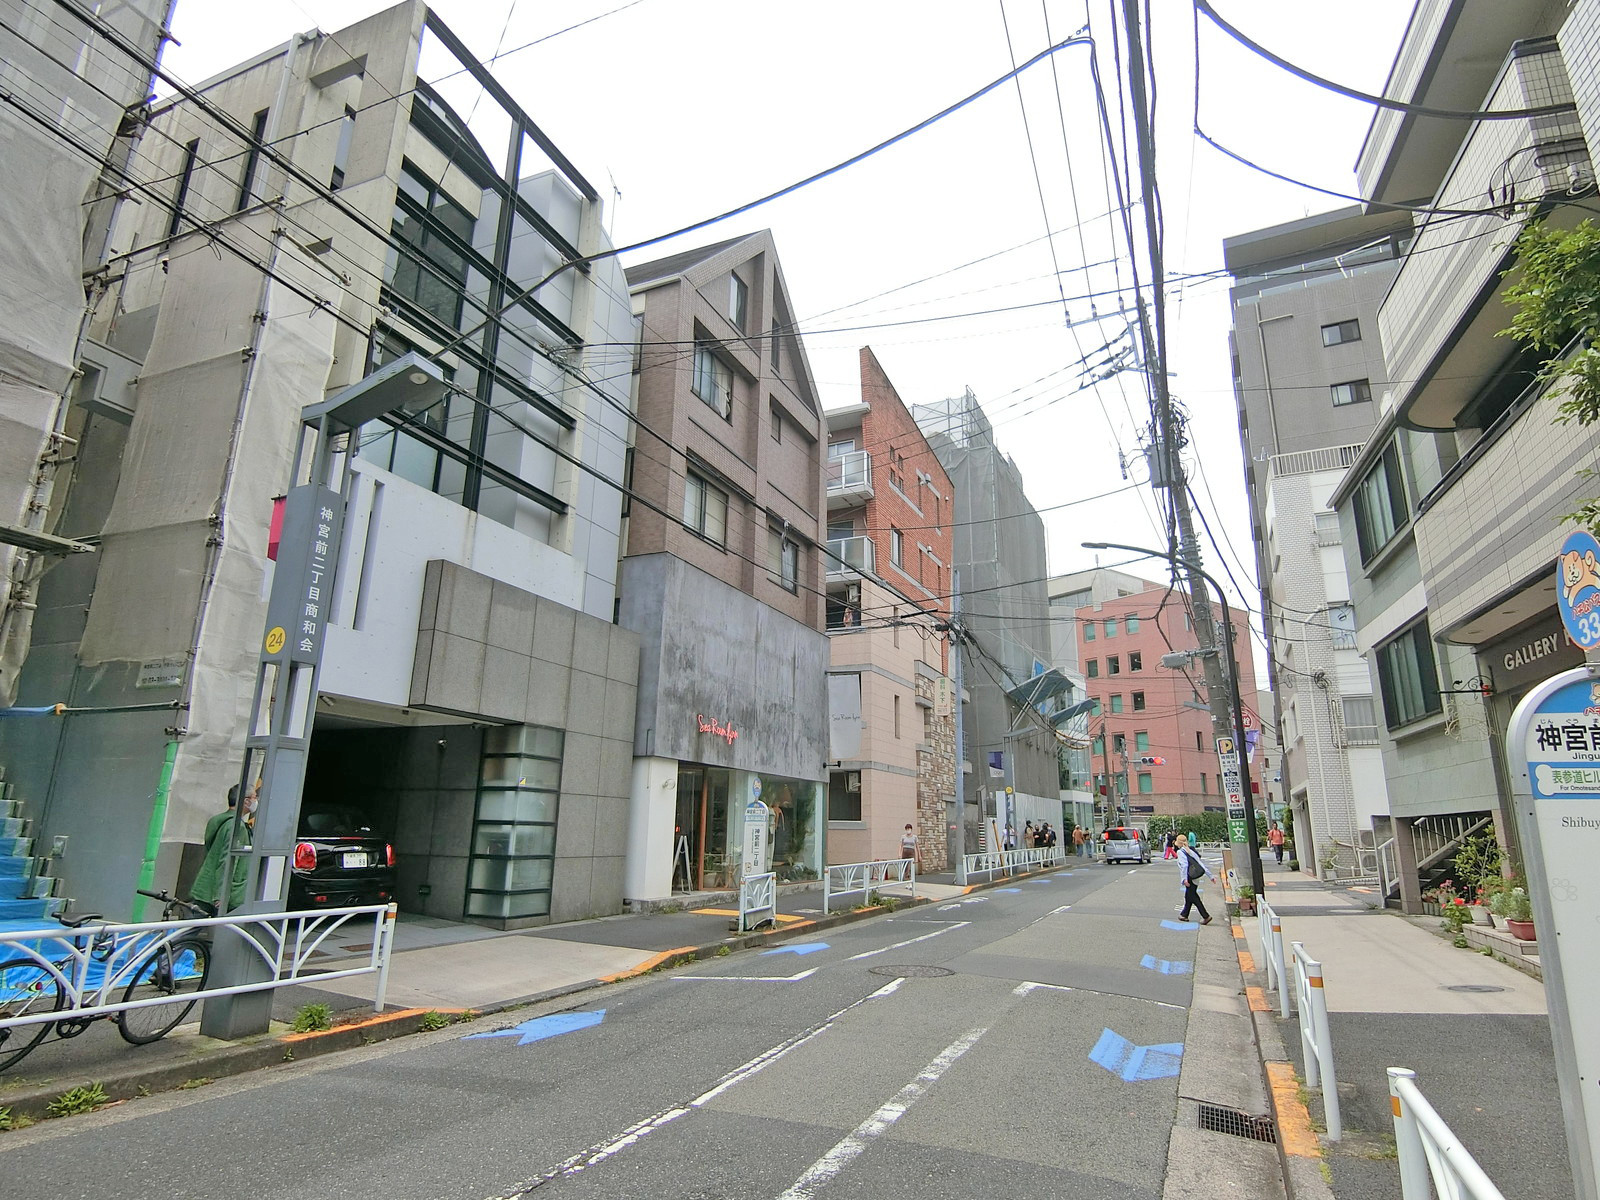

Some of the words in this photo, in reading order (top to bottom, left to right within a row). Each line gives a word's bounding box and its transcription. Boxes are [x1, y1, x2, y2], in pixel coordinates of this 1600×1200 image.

[300, 506, 333, 653] 神宮前二丁目商和会
[268, 635, 283, 648] 24
[1504, 632, 1558, 671] GALLERY
[1220, 739, 1232, 754] P
[1561, 815, 1600, 831] Shibuy
